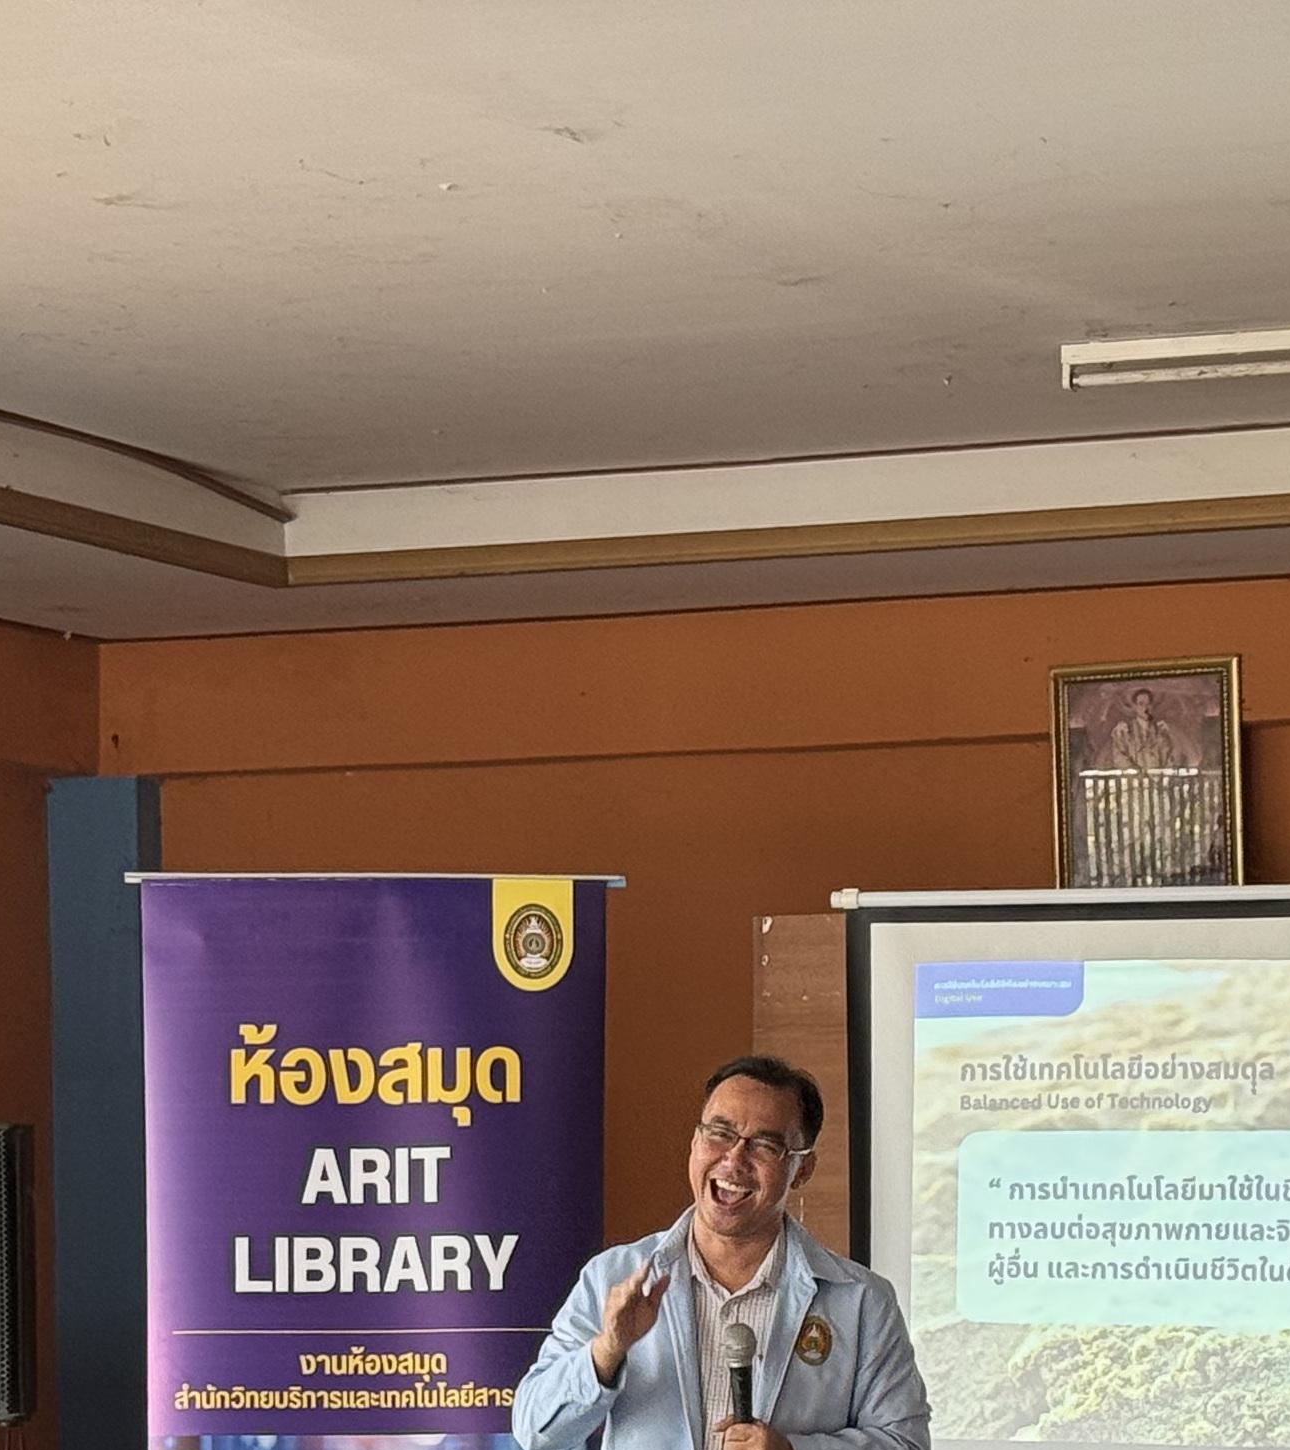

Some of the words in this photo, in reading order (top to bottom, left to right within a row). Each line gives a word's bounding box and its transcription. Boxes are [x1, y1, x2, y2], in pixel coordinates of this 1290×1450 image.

[229, 1023, 523, 1128] ห้องสมุด
[960, 1054, 1275, 1096] การใช้เทคโนโลยีอย่างสมดุล
[959, 1094, 1042, 1112] Balanced
[1047, 1094, 1081, 1110] Use
[1084, 1092, 1104, 1109] of
[1108, 1092, 1214, 1114] Technology
[301, 1146, 451, 1205] ARIT
[233, 1234, 520, 1294] LIBRARY
[987, 1248, 1038, 1286] ผู้อื่น
[299, 1346, 448, 1381] งานห้องสมุด
[174, 1381, 514, 1410] สำนักวิทยบริการและเทคโนโลยีสาร
